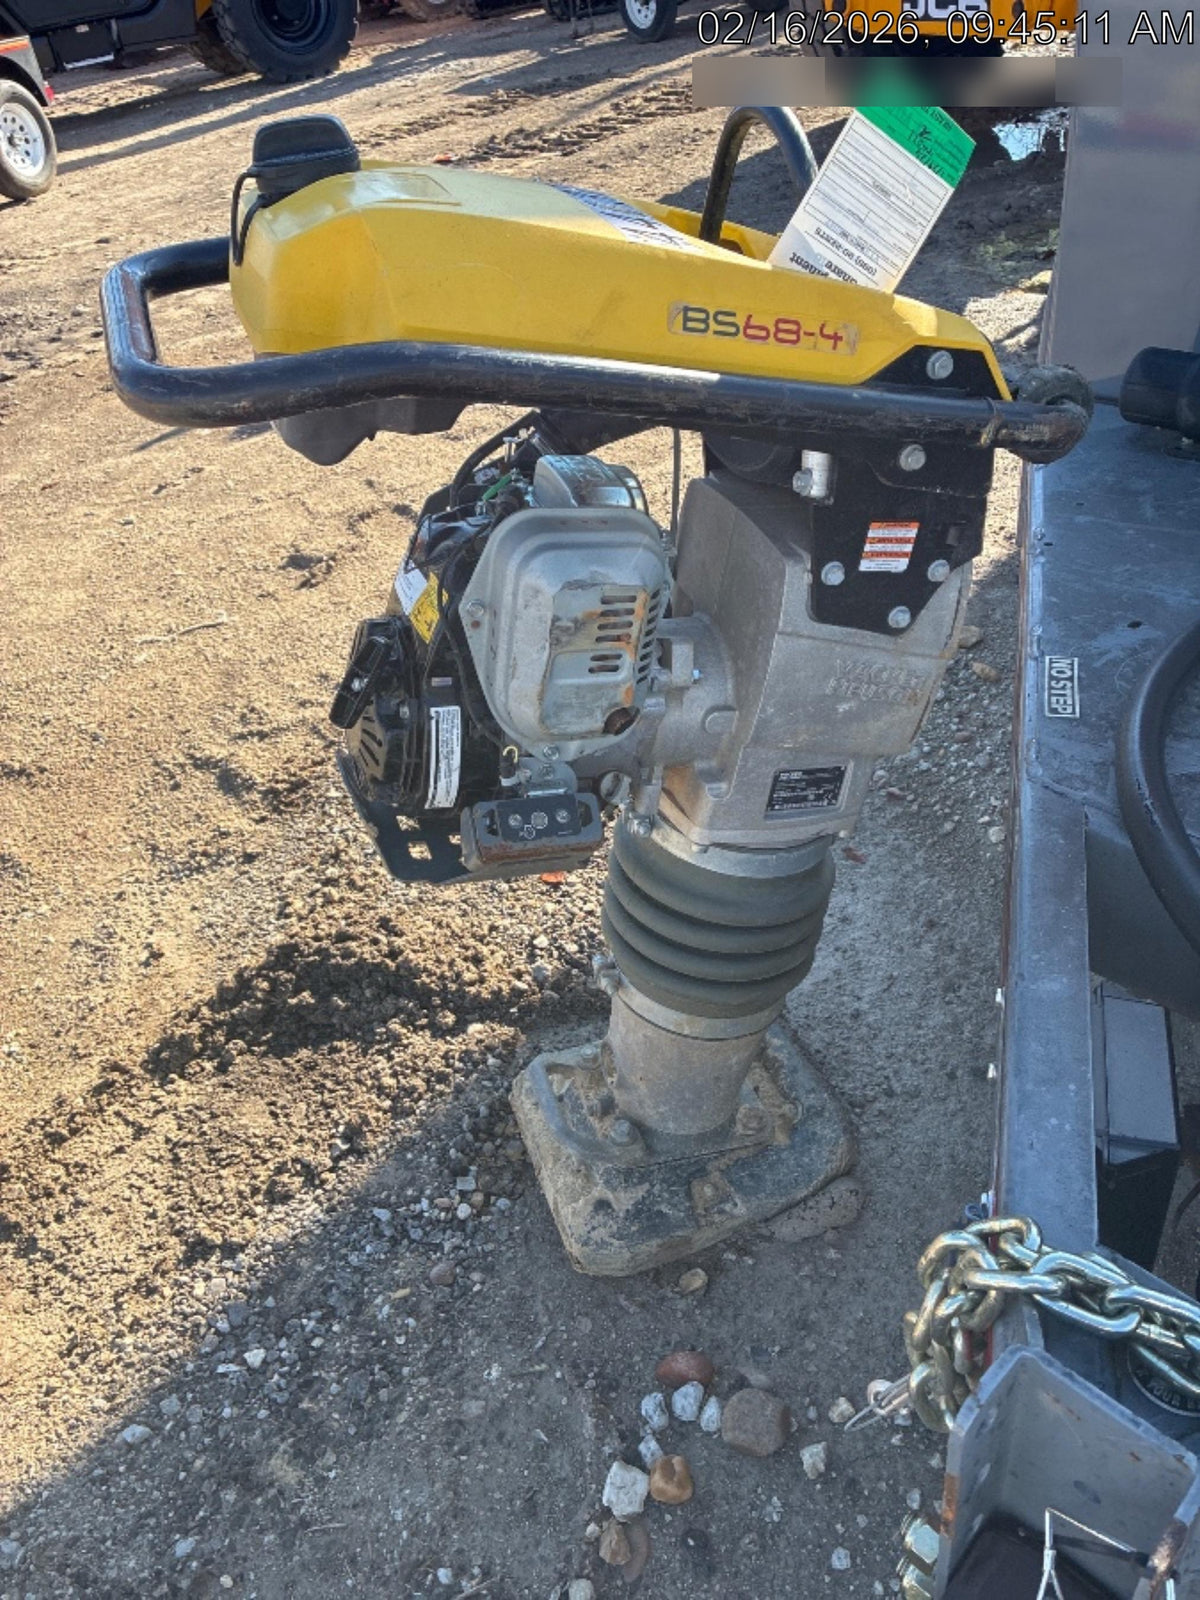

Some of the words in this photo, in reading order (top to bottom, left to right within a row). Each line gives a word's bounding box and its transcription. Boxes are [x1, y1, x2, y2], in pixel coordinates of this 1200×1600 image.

[682, 305, 843, 351] BS68-4
[1050, 659, 1073, 678] NO
[1050, 680, 1073, 713] STEP
